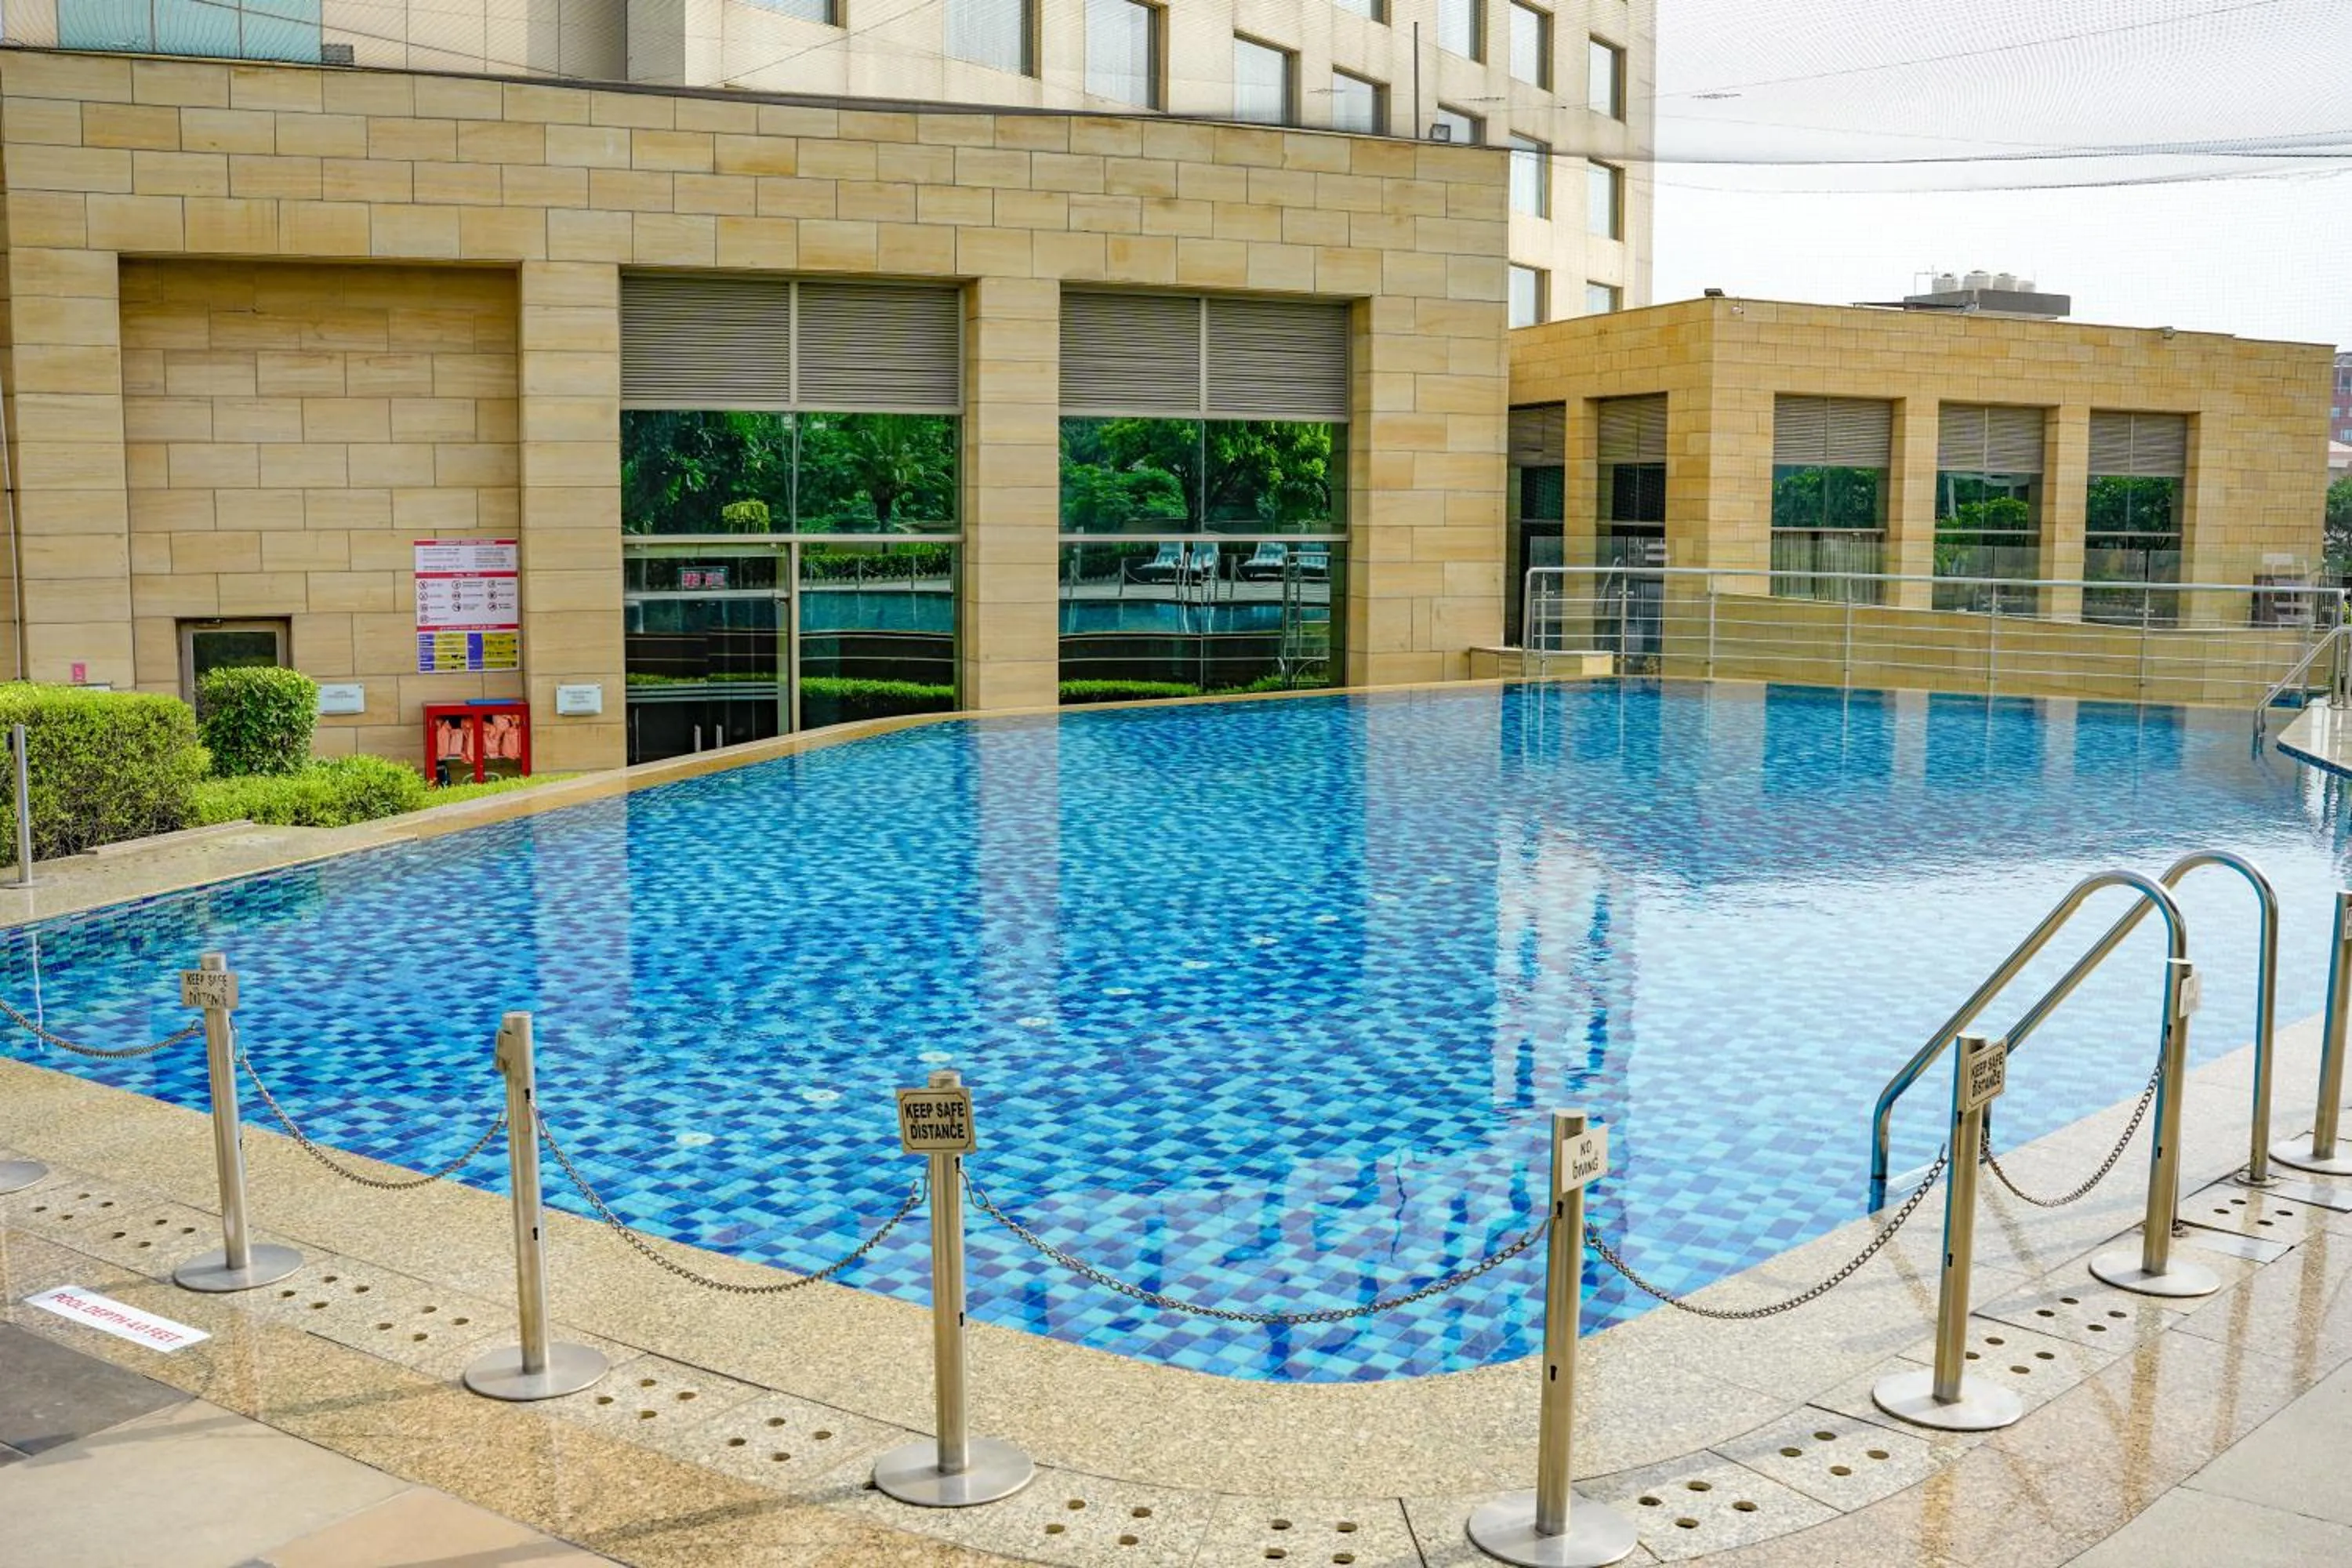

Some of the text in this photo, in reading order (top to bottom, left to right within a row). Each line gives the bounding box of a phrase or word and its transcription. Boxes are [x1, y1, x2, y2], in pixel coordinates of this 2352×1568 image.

[1971, 1051, 2003, 1080] KEEP SAFE
[904, 1102, 965, 1118] KEEP SAFE
[910, 1123, 965, 1139] DISTANCE
[1580, 1140, 1592, 1156] NO
[50, 1293, 87, 1309] POOL
[82, 1305, 132, 1324] DEPTH
[143, 1327, 183, 1343] FEET
